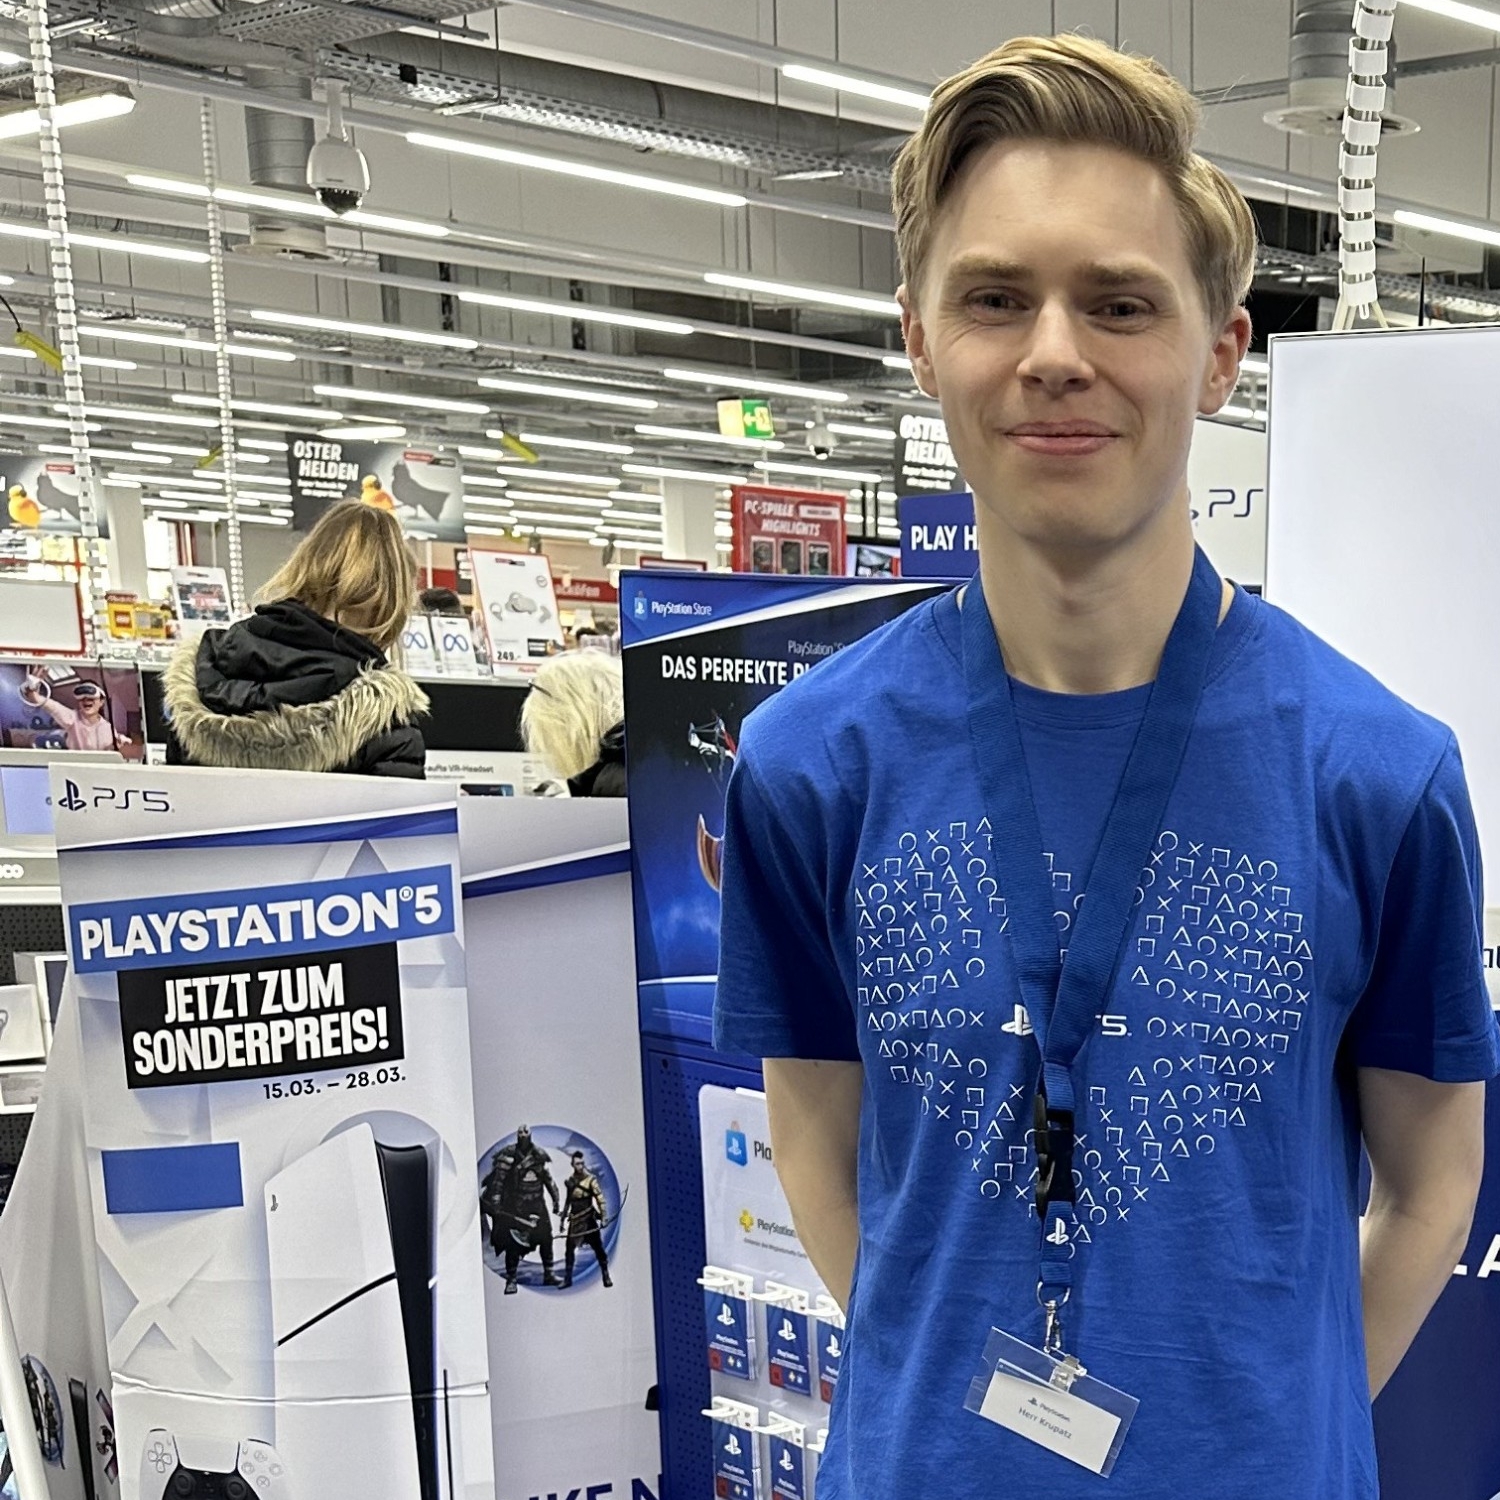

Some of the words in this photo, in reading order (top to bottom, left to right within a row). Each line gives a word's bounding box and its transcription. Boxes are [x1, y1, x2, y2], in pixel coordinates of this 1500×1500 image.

[293, 440, 342, 461] OSTER
[299, 459, 359, 481] HELDEN
[744, 500, 795, 517] PC-SPIELE
[761, 519, 821, 537] HIGHLIGHTS
[911, 525, 957, 551] PLAY
[651, 601, 693, 617] PlayStation
[693, 602, 712, 616] Store
[661, 655, 697, 680] DAS
[701, 657, 788, 685] PERFEKTE
[92, 787, 170, 812] PS5
[164, 973, 251, 1024] JETZT
[258, 963, 345, 1016] ZUM
[132, 1006, 390, 1076] SONDERPREIS!
[263, 1080, 321, 1100] 15.03.
[345, 1066, 406, 1090] 28.03.
[1018, 1406, 1038, 1422] Herr
